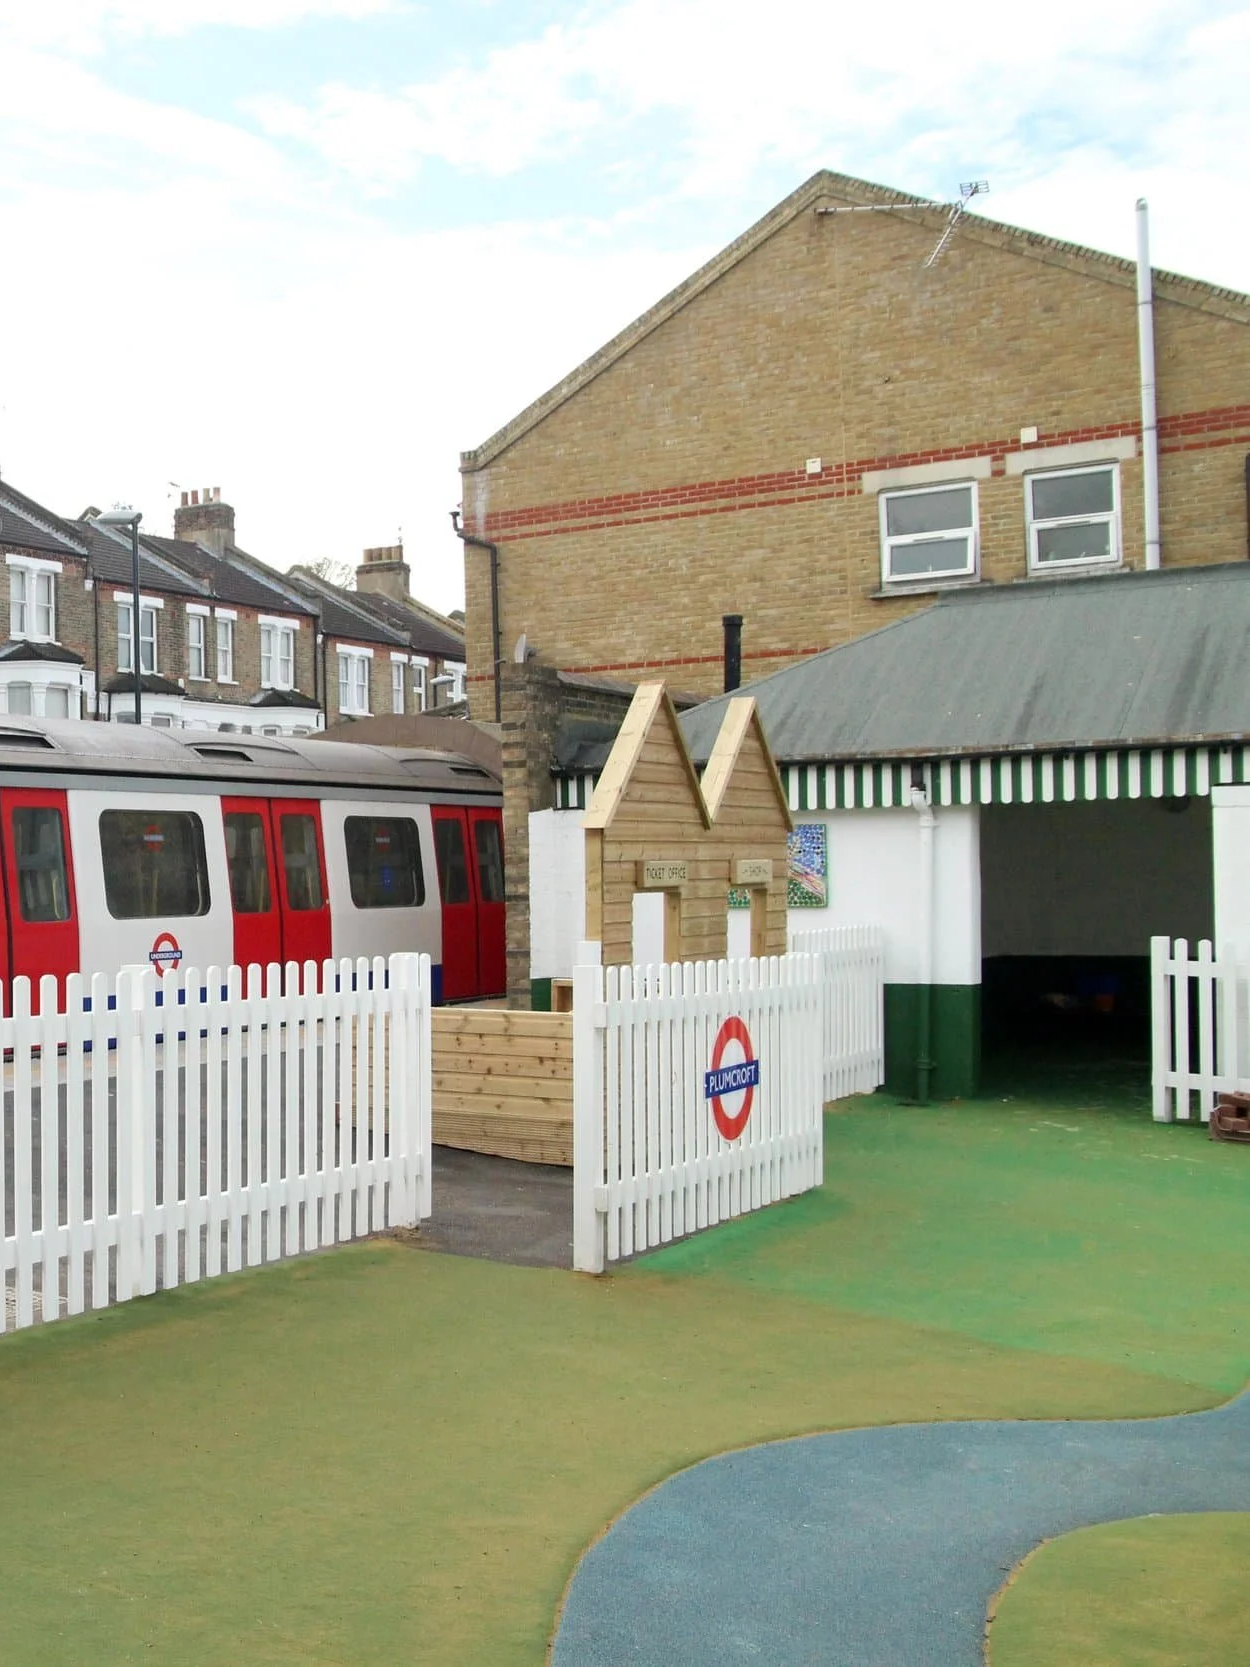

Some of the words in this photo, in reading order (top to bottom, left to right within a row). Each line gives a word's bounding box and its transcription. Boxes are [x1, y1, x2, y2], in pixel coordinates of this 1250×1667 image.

[646, 867, 665, 880] TICKET
[668, 866, 687, 879] OFFICE
[709, 1065, 755, 1093] PLUMCROFT
